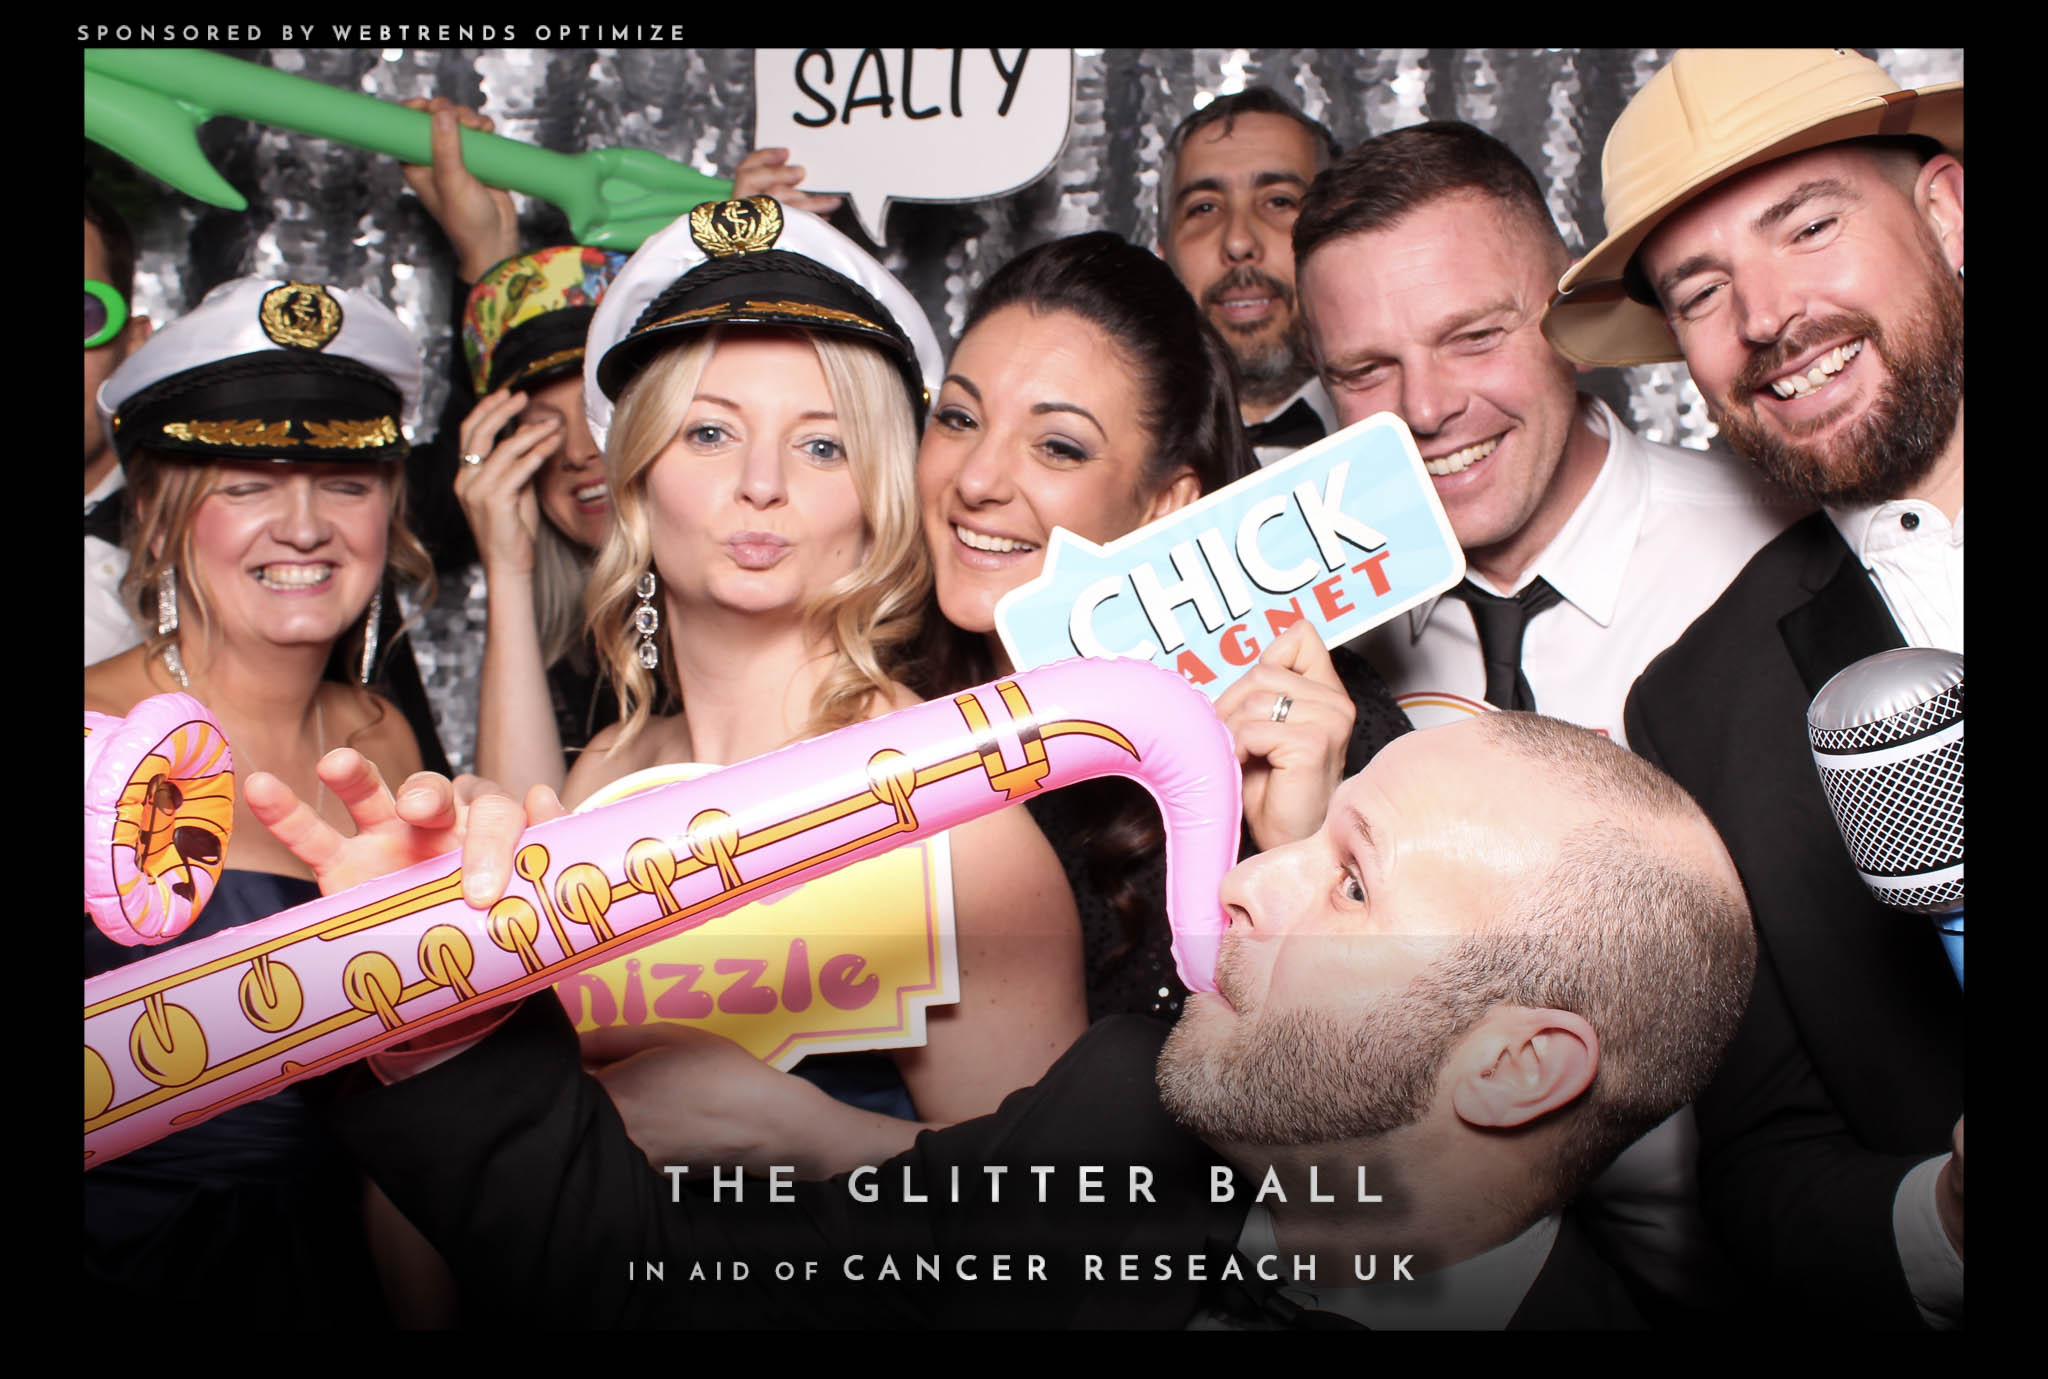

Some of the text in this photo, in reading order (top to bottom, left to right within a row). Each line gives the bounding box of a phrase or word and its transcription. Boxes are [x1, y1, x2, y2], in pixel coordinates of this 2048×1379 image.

[793, 48, 1030, 128] SALTY
[1068, 460, 1388, 661] CHICK
[1176, 550, 1390, 686] AGNET
